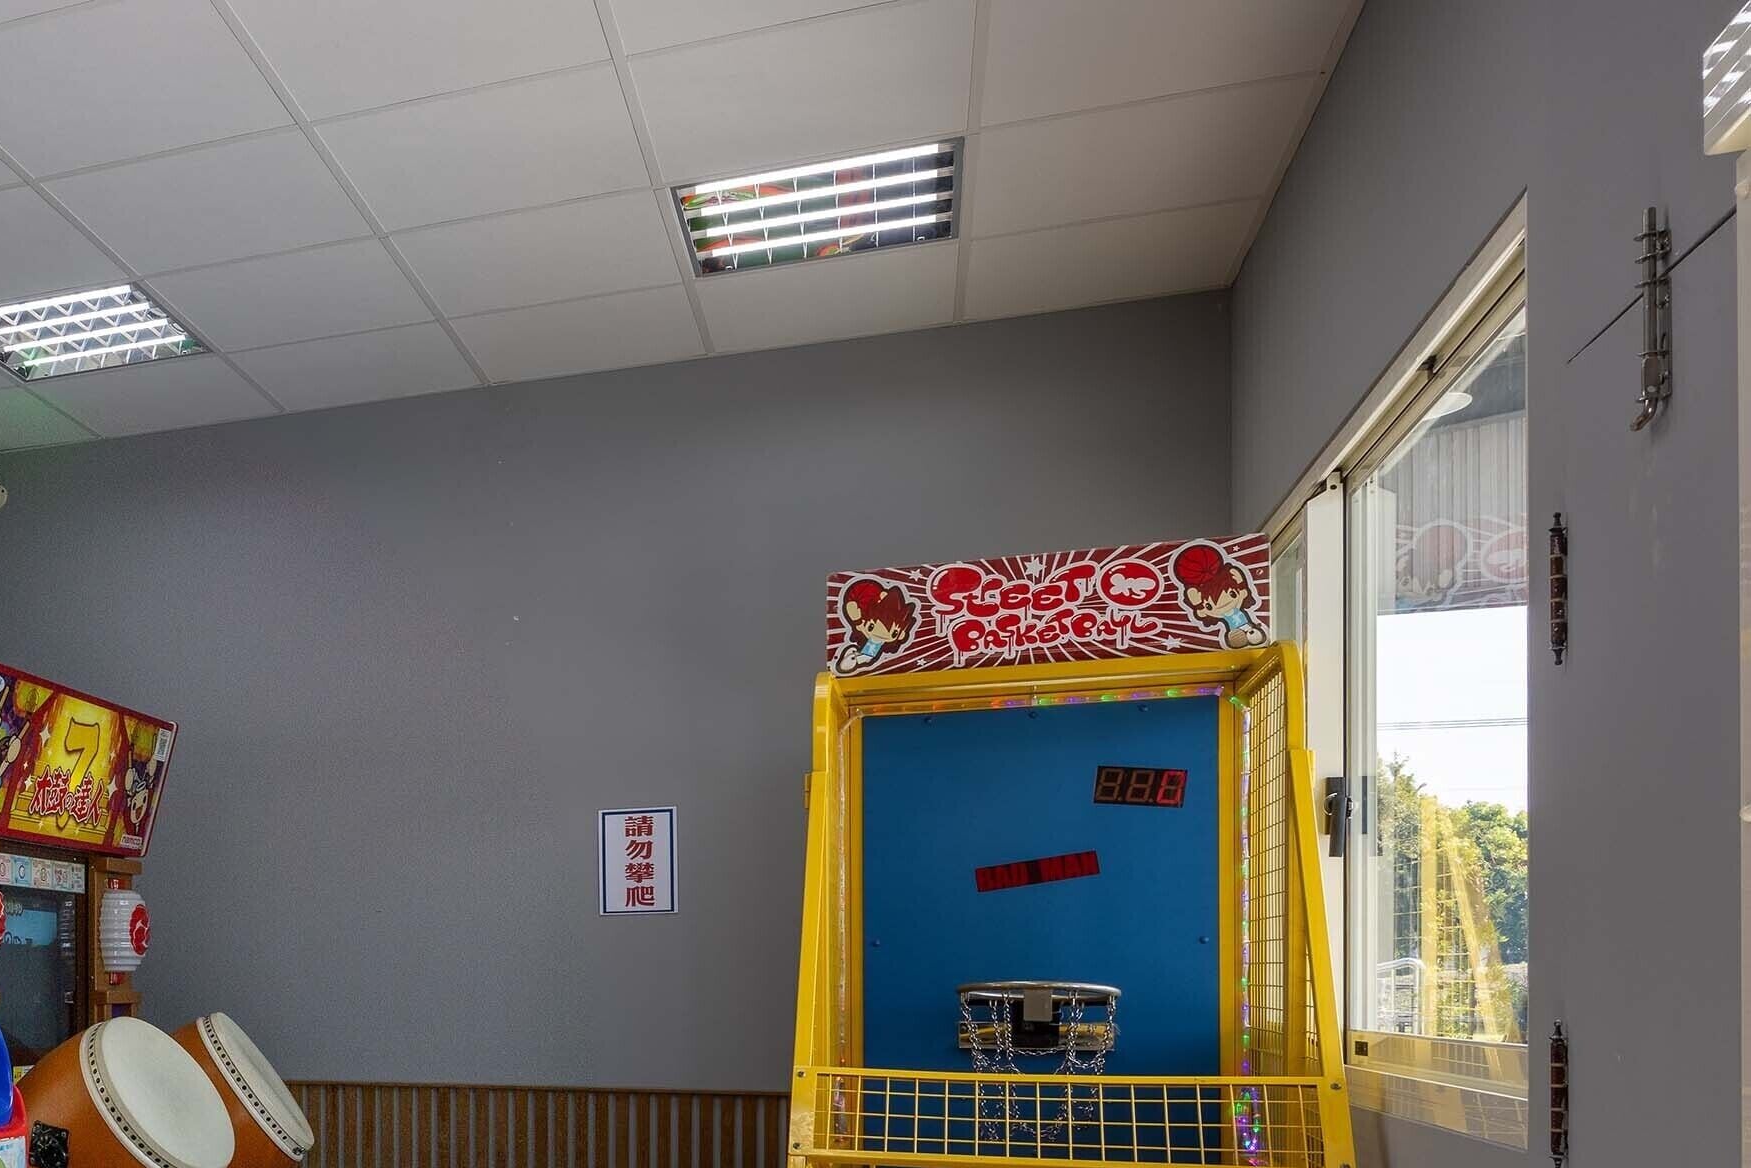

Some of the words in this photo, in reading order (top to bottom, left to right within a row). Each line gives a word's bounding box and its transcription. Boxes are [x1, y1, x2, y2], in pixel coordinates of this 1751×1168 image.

[28, 764, 105, 827] 太鼓の達人
[624, 815, 655, 907] 請勿攀爬
